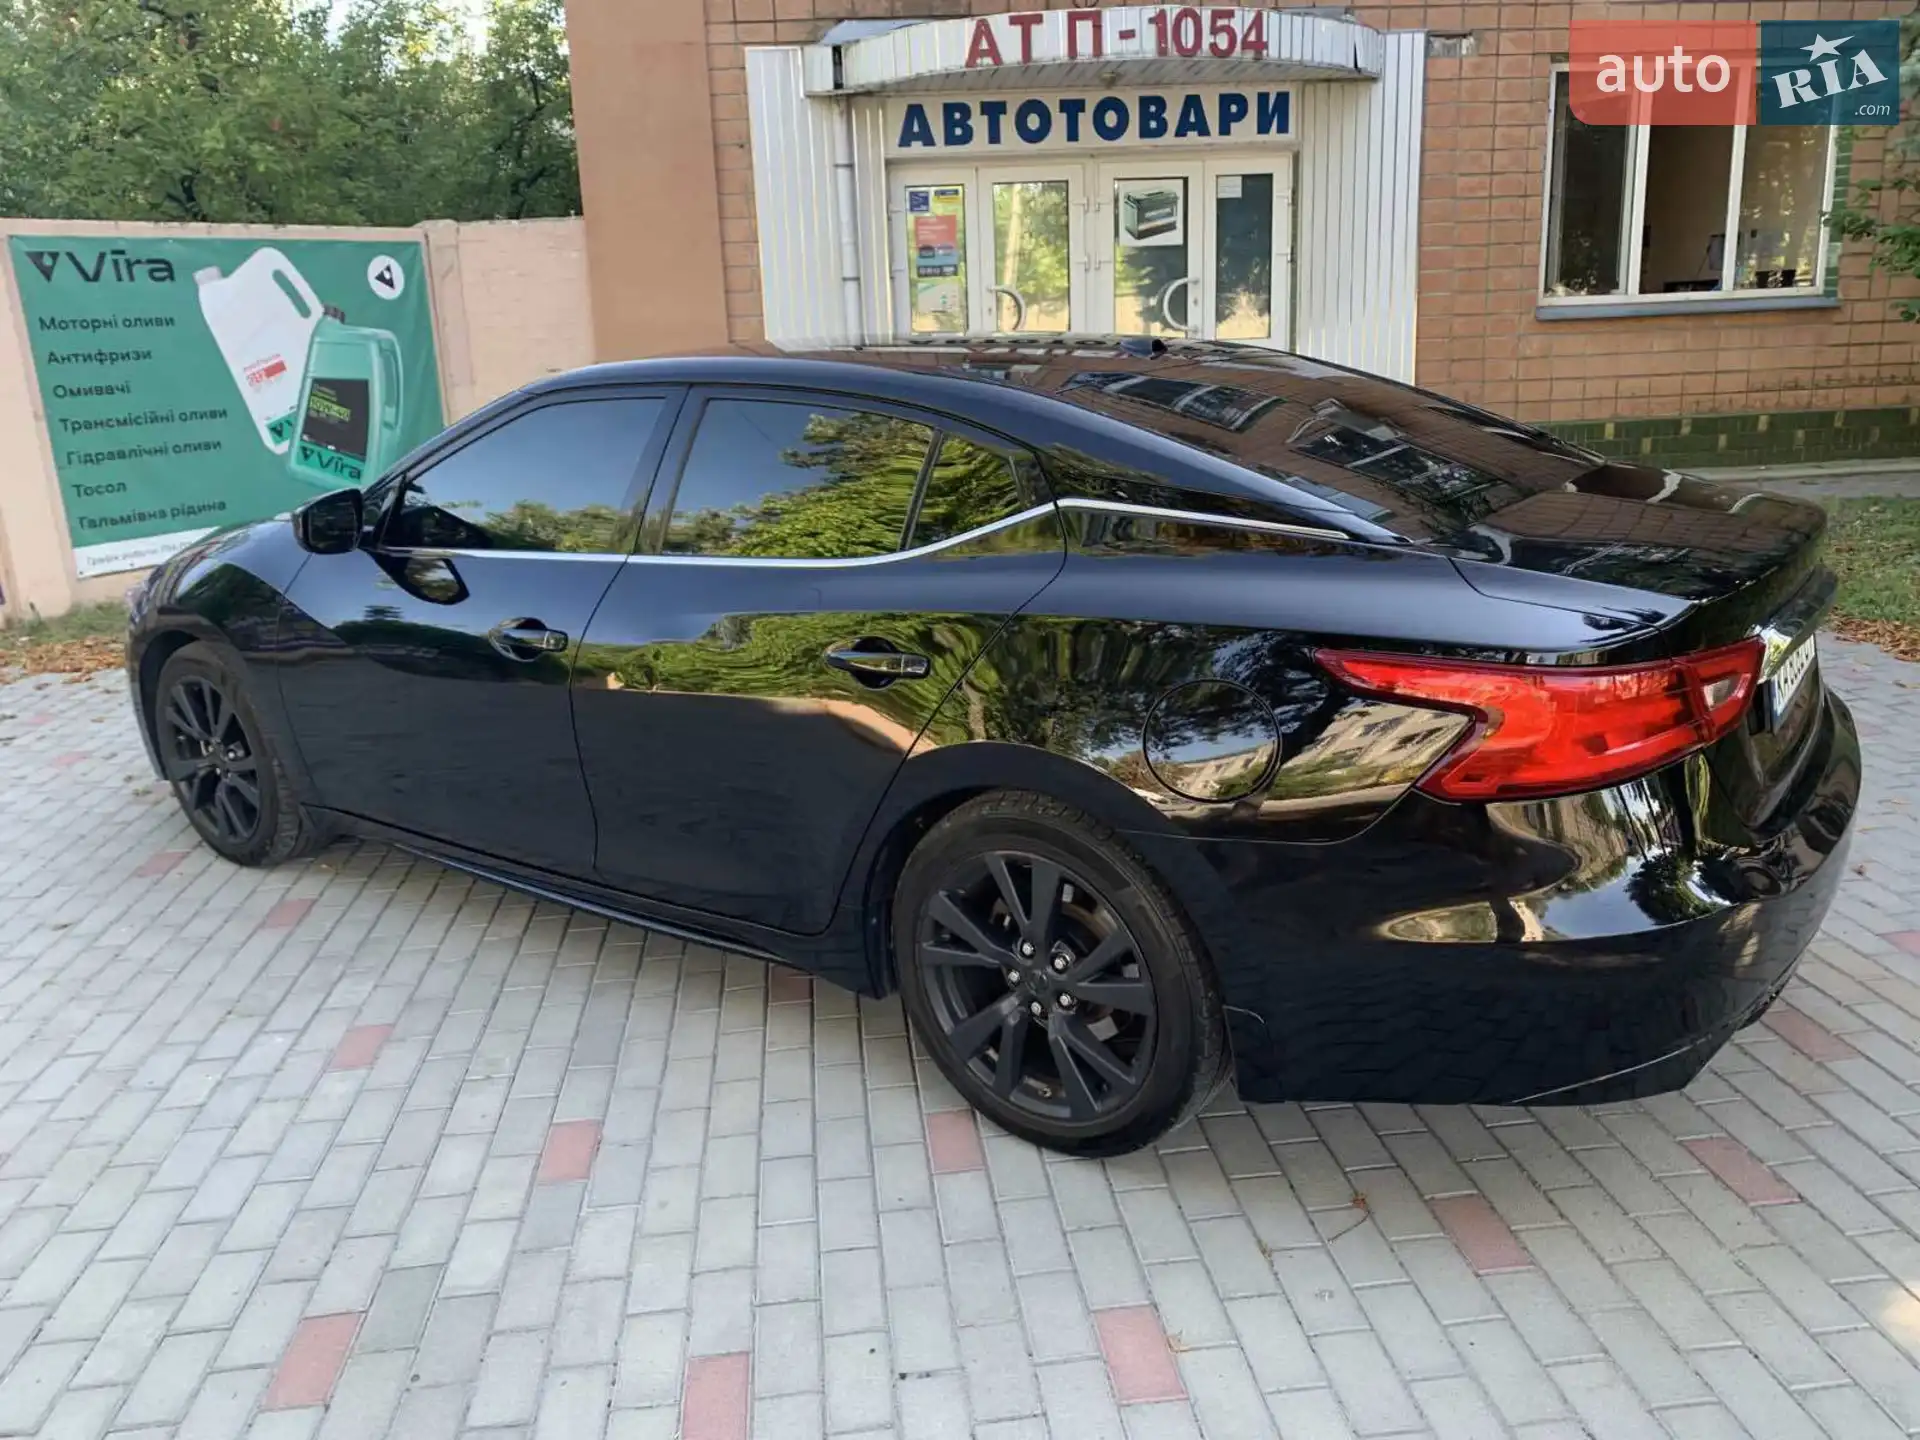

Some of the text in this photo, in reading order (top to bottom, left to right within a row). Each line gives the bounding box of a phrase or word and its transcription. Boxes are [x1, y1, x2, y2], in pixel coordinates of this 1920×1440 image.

[898, 91, 1290, 148] АВТОТОВАРИ
[38, 314, 176, 333] Моторні оливи
[47, 348, 153, 366] Антифризи
[52, 380, 131, 399] Омивачі
[58, 408, 228, 435] Трансмісійні оливи
[66, 440, 222, 467] Гідравлічні оливи
[71, 481, 127, 498] Тосол
[77, 500, 227, 530] Гальмівна рідина
